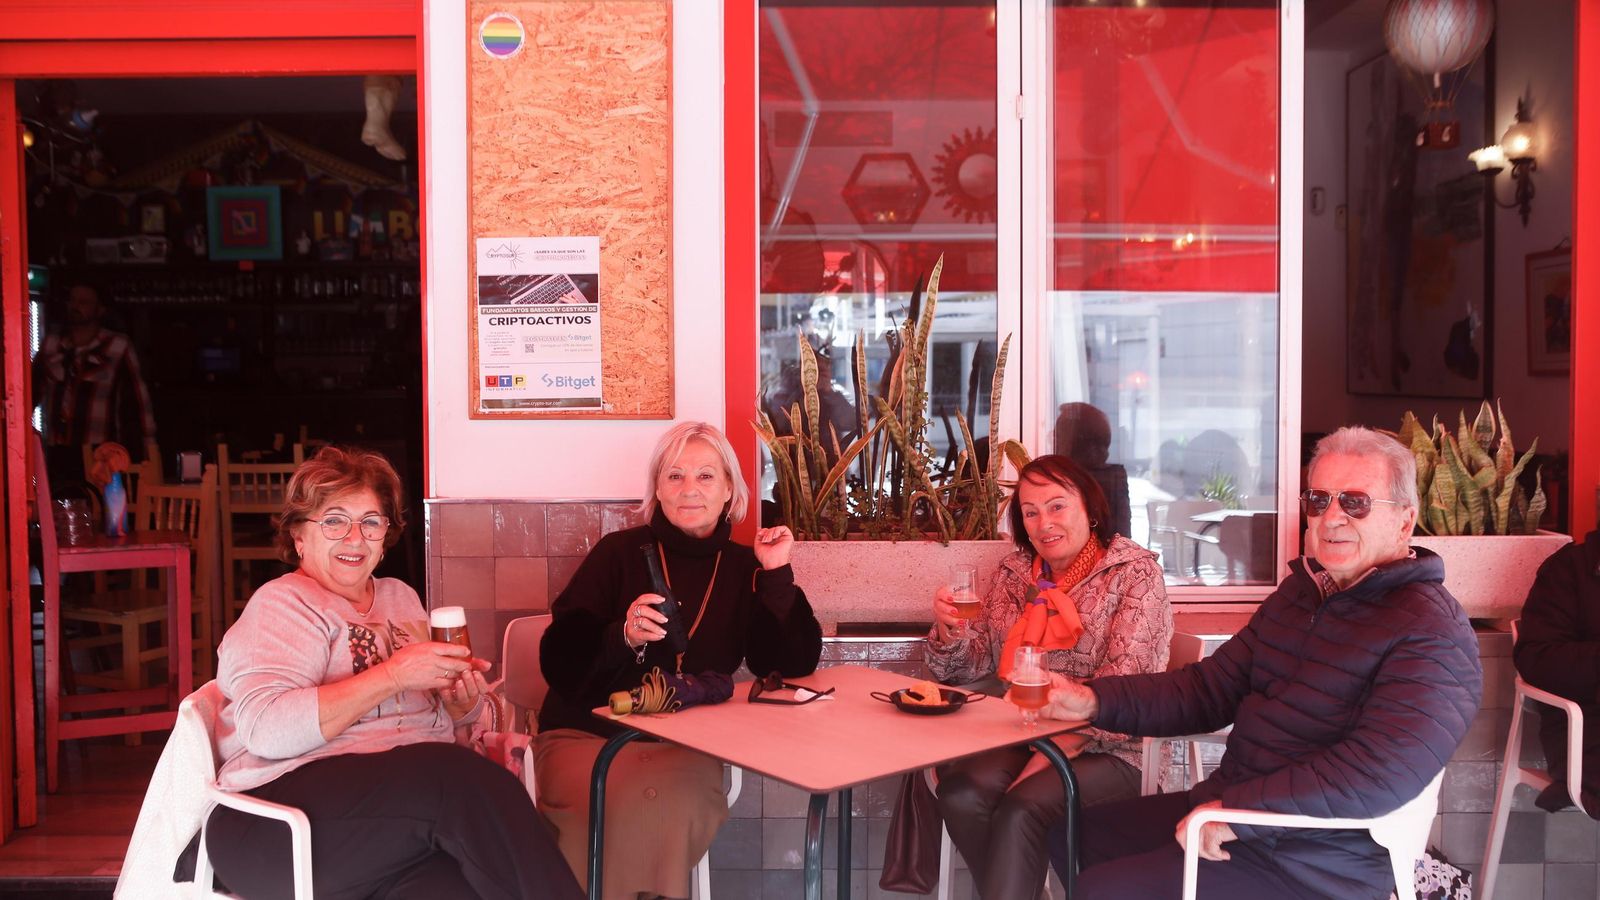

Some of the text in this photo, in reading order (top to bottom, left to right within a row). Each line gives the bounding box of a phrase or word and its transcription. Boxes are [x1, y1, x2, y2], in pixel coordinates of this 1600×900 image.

[313, 210, 418, 240] LIB
[488, 315, 592, 326] CRIPTOACTIVOS
[487, 376, 524, 386] UTP
[555, 375, 596, 390] Bitget
